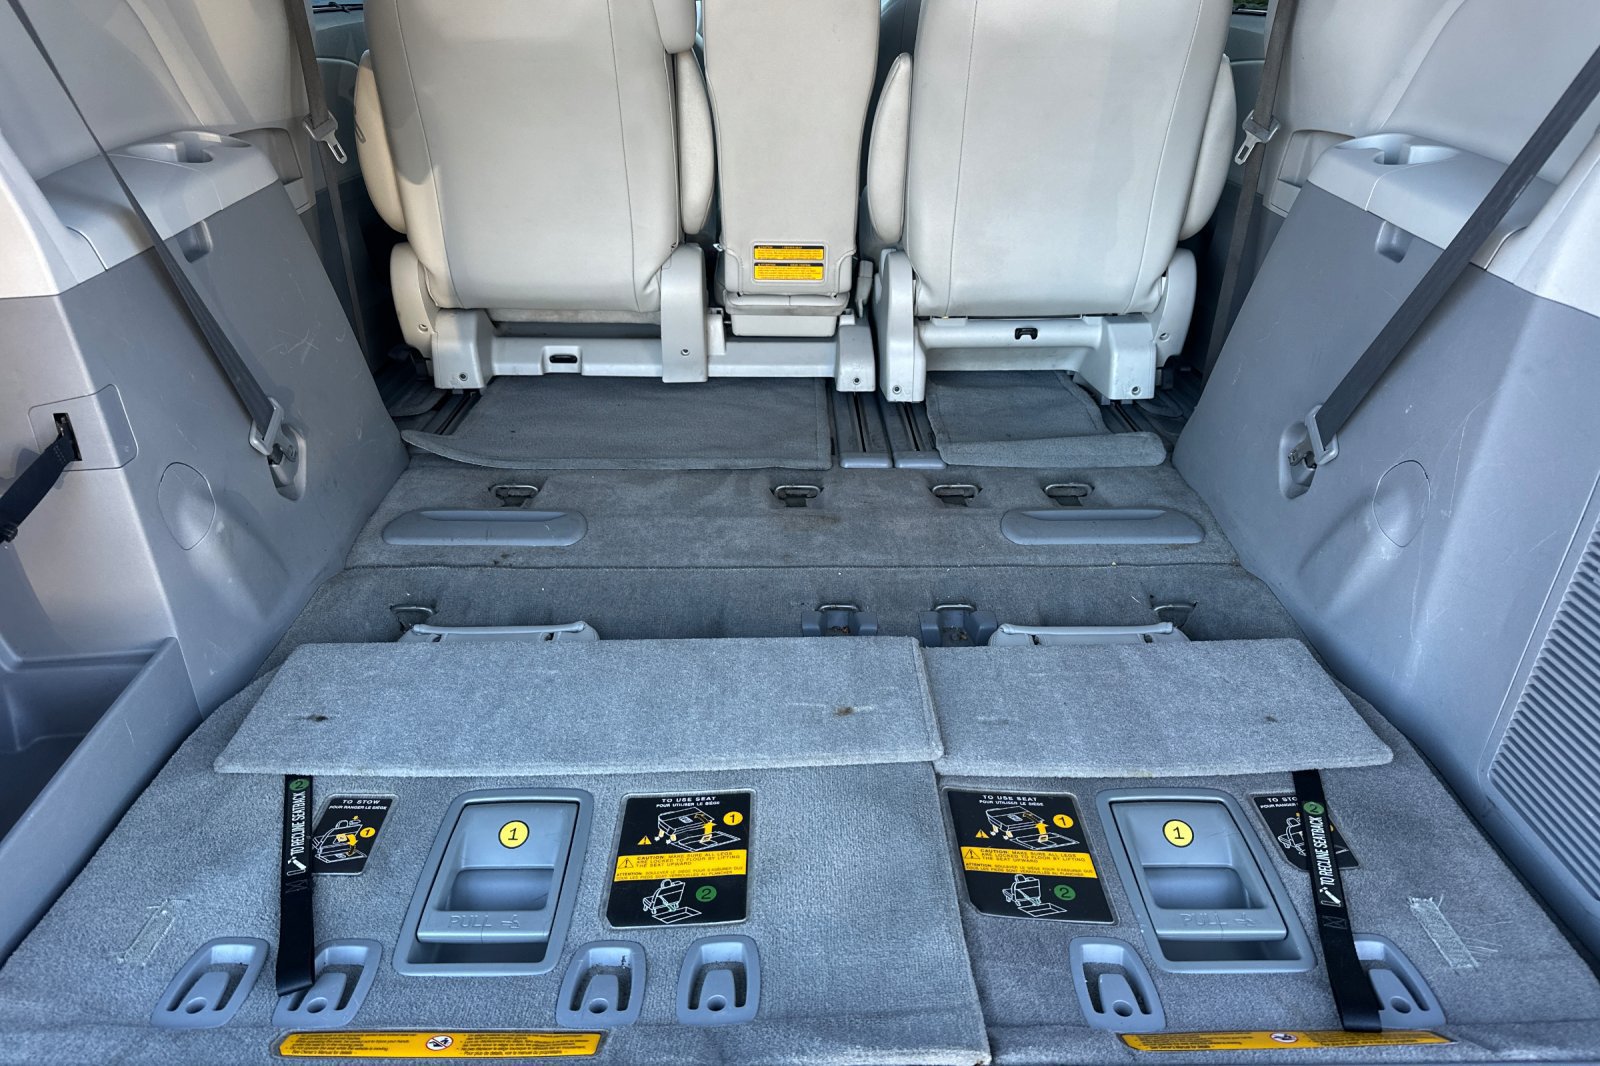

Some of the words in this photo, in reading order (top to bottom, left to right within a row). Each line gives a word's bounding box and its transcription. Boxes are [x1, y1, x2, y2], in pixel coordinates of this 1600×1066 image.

[292, 790, 306, 821] SEATBACK
[290, 821, 305, 847] RECLINE
[1309, 816, 1328, 848] SEATBACK
[290, 846, 304, 856] TO
[1315, 848, 1334, 877] RECLINE
[1320, 876, 1335, 885] TO
[450, 914, 492, 927] PULL
